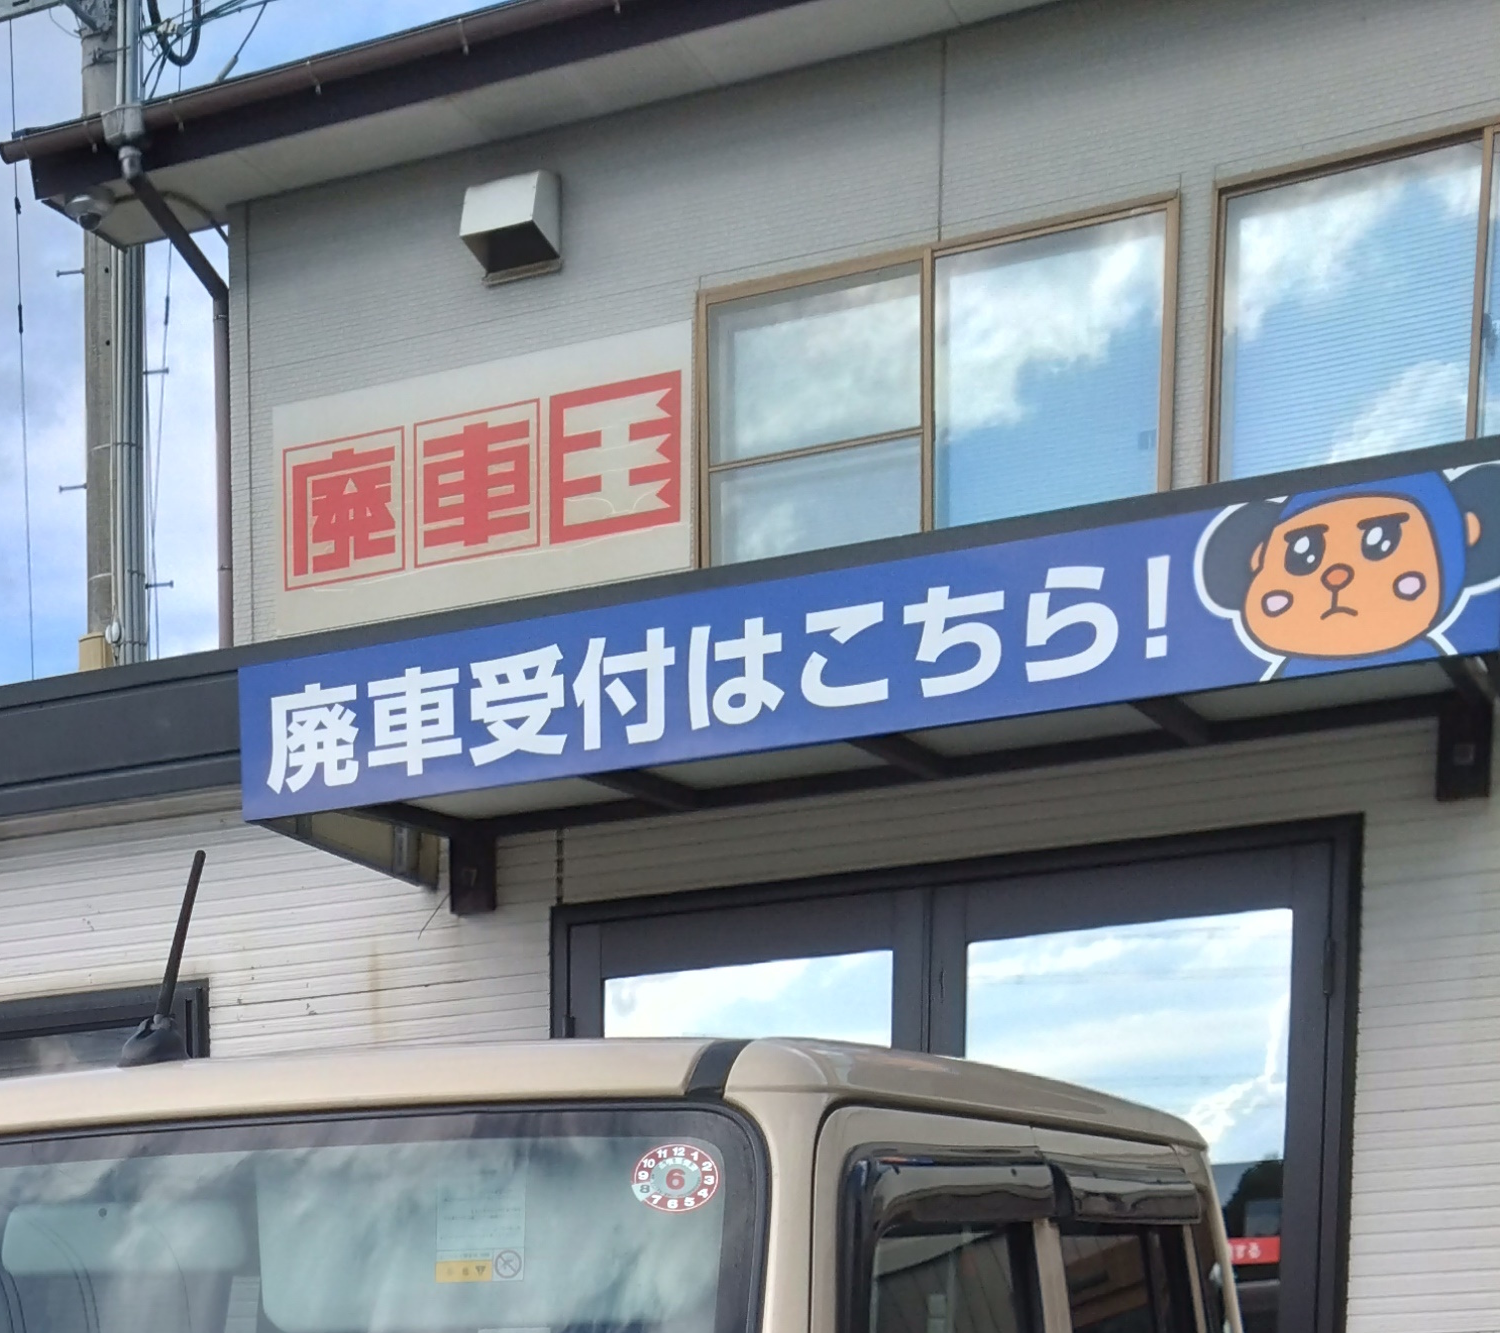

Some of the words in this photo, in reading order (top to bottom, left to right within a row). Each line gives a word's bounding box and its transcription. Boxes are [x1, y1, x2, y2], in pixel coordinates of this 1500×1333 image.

[290, 383, 675, 578] 廃車王
[657, 1149, 668, 1158] 11
[672, 1147, 685, 1156] 12
[690, 1151, 699, 1161] 1
[642, 1159, 655, 1168] 10
[701, 1161, 712, 1171] 2
[638, 1171, 649, 1180] 9
[666, 1168, 685, 1190] 6
[703, 1175, 714, 1185] 3
[640, 1184, 650, 1193] 8
[697, 1188, 708, 1198] 4
[651, 1195, 662, 1204] 7
[667, 1199, 678, 1209] 6
[684, 1197, 695, 1207] 5
